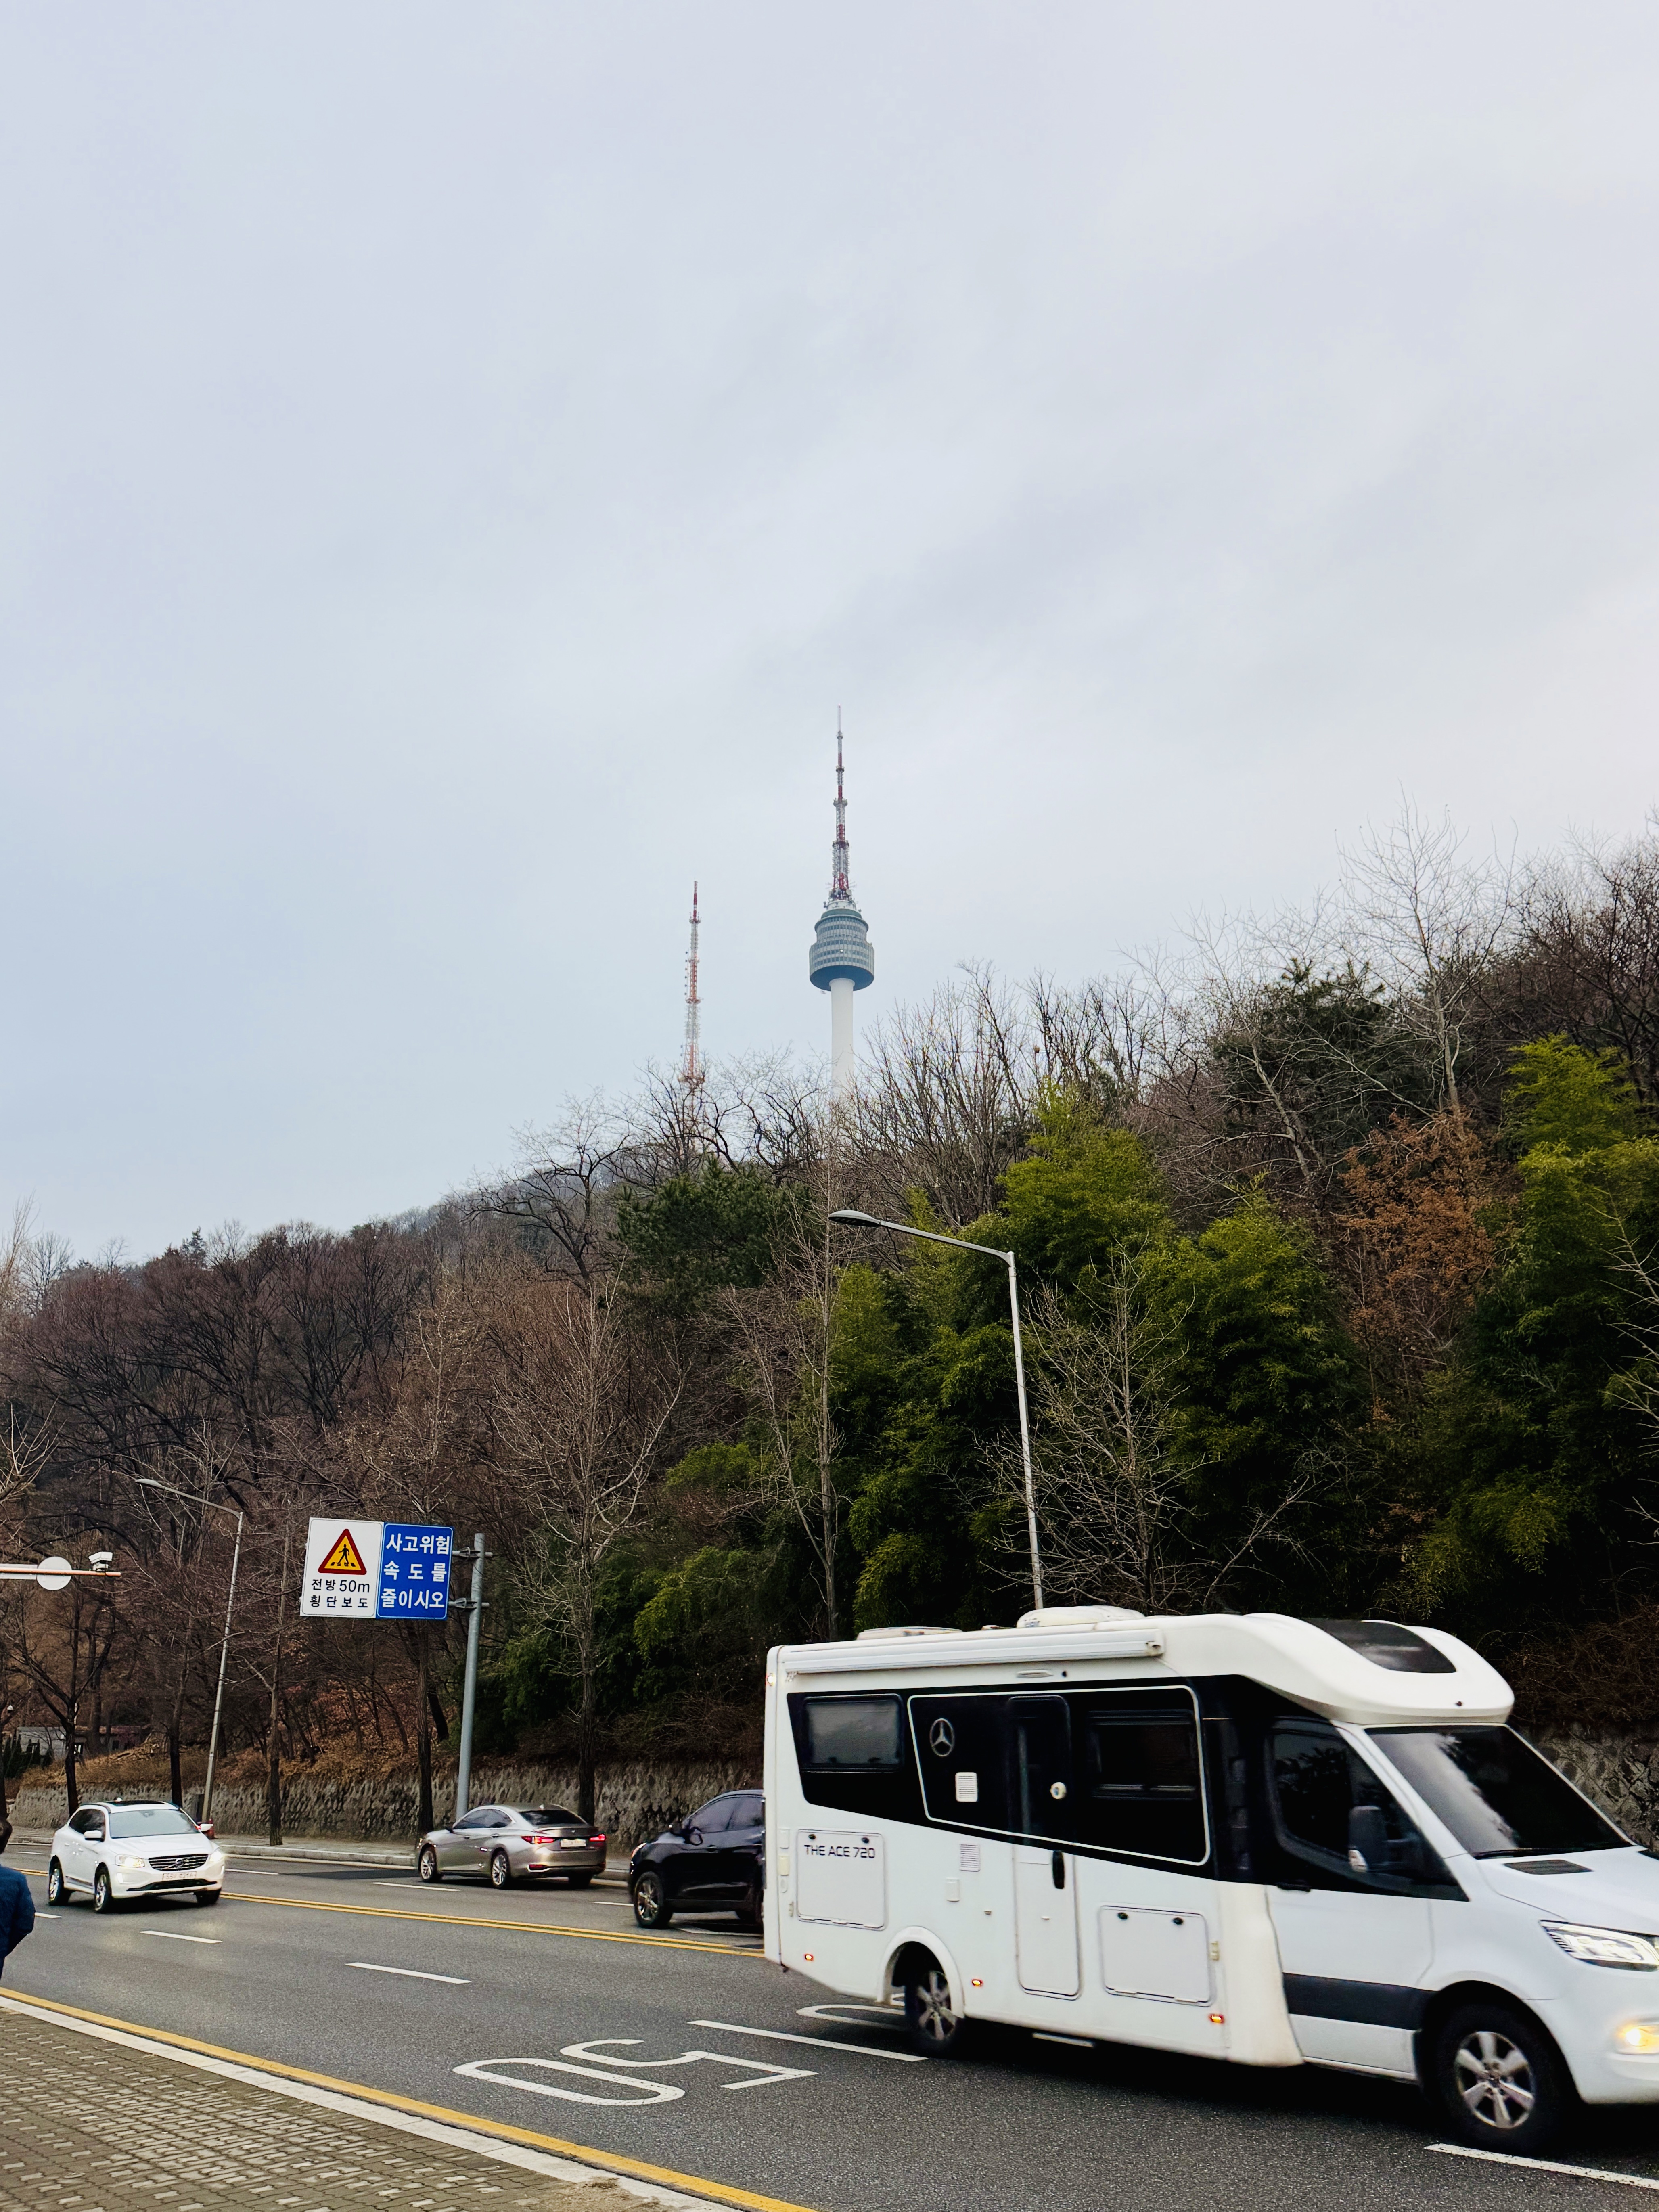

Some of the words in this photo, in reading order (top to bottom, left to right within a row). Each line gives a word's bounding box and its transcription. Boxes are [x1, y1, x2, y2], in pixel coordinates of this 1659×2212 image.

[386, 1533, 450, 1555] 사고위험
[311, 1578, 336, 1591] 전방
[339, 1580, 370, 1593] 50m
[310, 1595, 368, 1608] 횡단보도
[381, 1588, 445, 1609] 줄이시오
[804, 1845, 825, 1856] THE
[828, 1846, 850, 1857] ACE
[853, 1847, 875, 1858] 720
